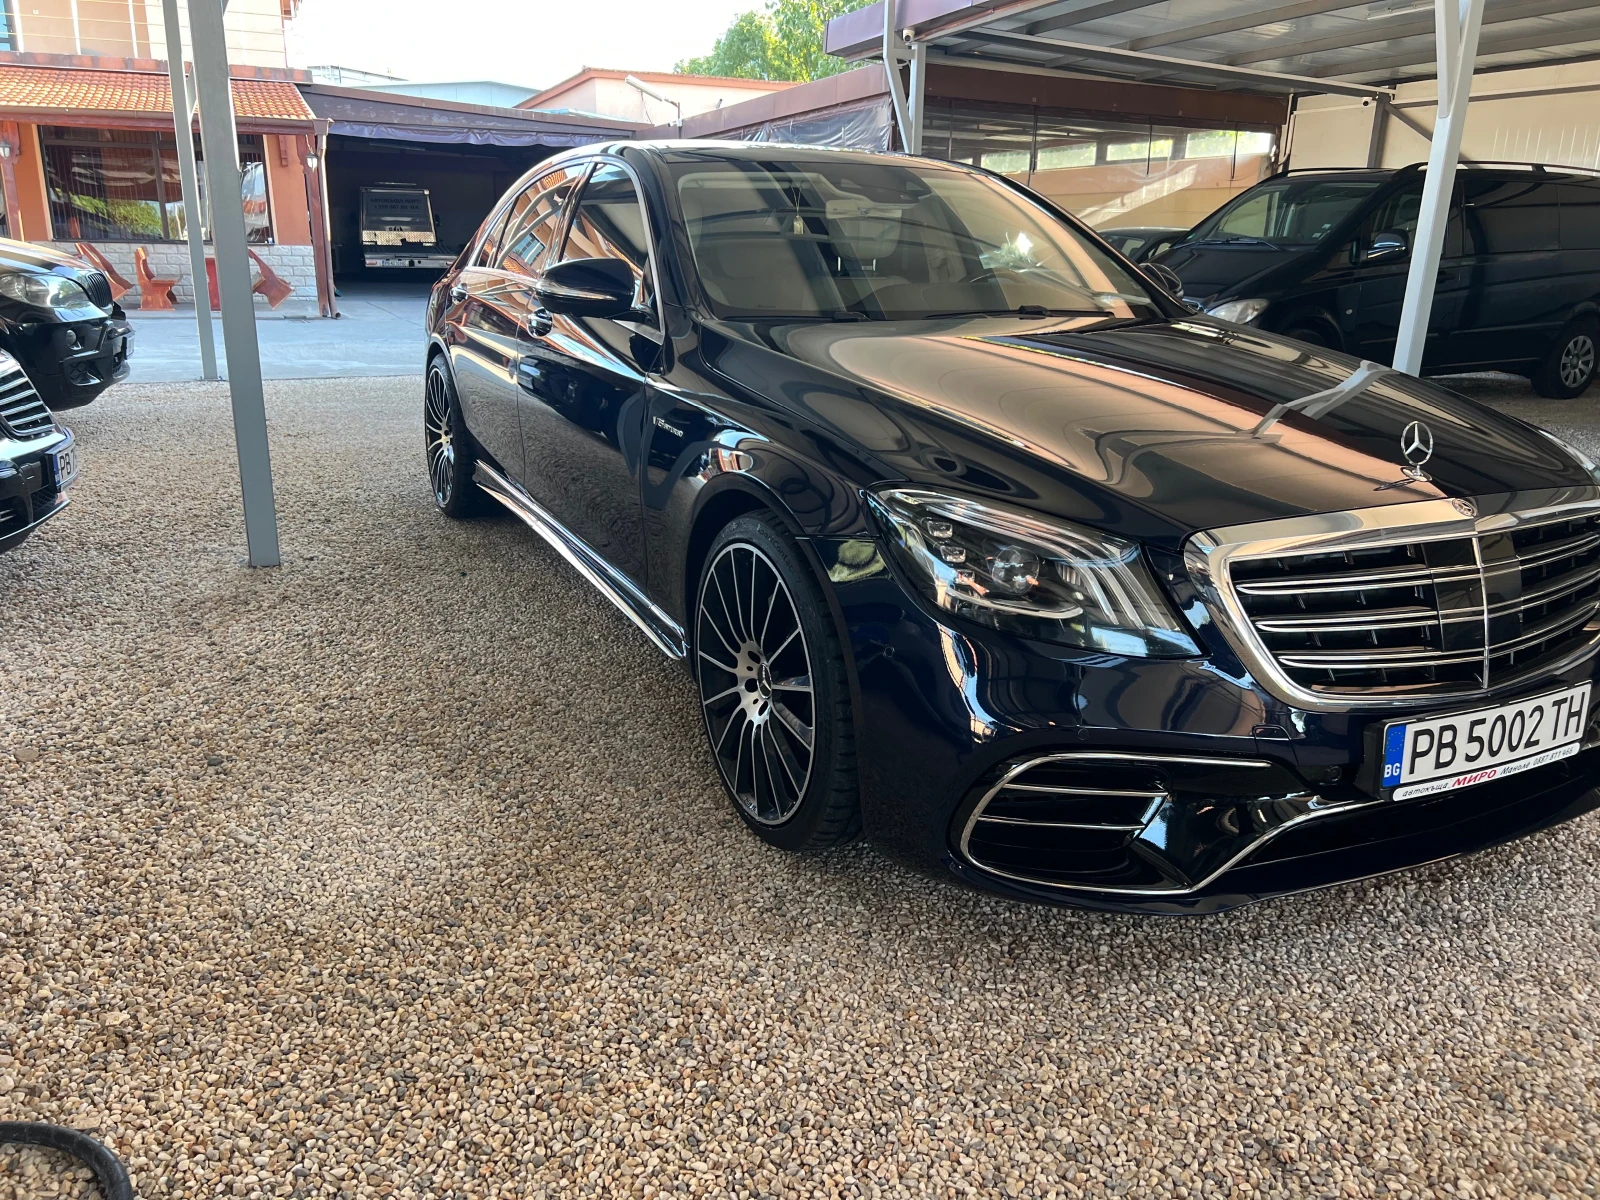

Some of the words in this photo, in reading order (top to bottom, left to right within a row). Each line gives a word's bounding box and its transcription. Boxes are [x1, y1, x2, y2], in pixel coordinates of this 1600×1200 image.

[1409, 723, 1458, 775] PB
[1464, 704, 1545, 763] 5002
[1551, 691, 1586, 741] TH
[1384, 763, 1401, 778] BG
[1451, 769, 1498, 788] МИРО
